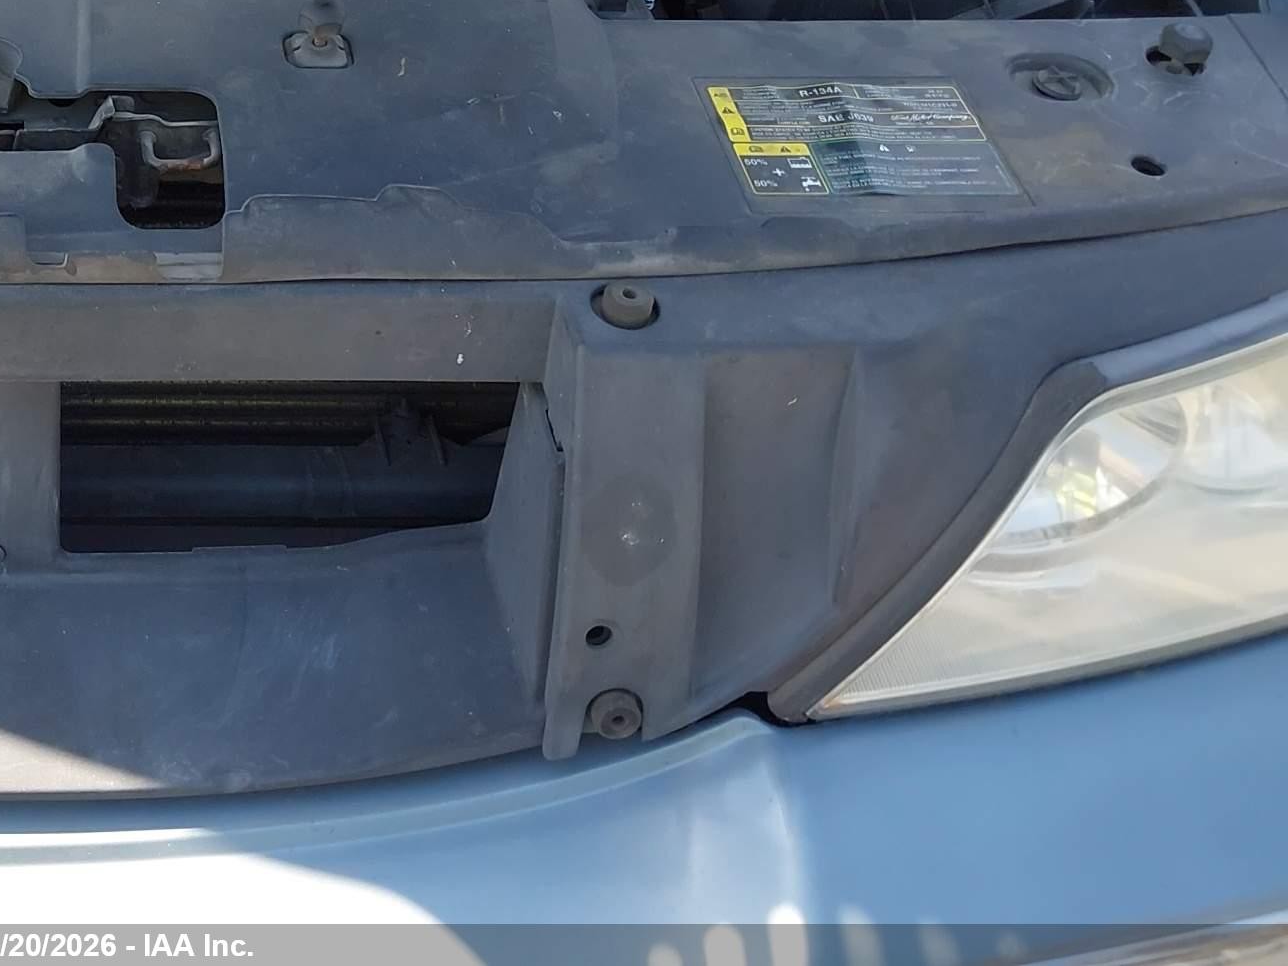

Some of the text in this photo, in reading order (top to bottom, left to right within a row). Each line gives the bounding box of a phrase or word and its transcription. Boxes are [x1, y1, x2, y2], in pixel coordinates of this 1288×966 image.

[799, 86, 843, 98] R-134A
[817, 113, 845, 123] SAE
[744, 158, 768, 166] 50%
[753, 179, 778, 187] 50%
